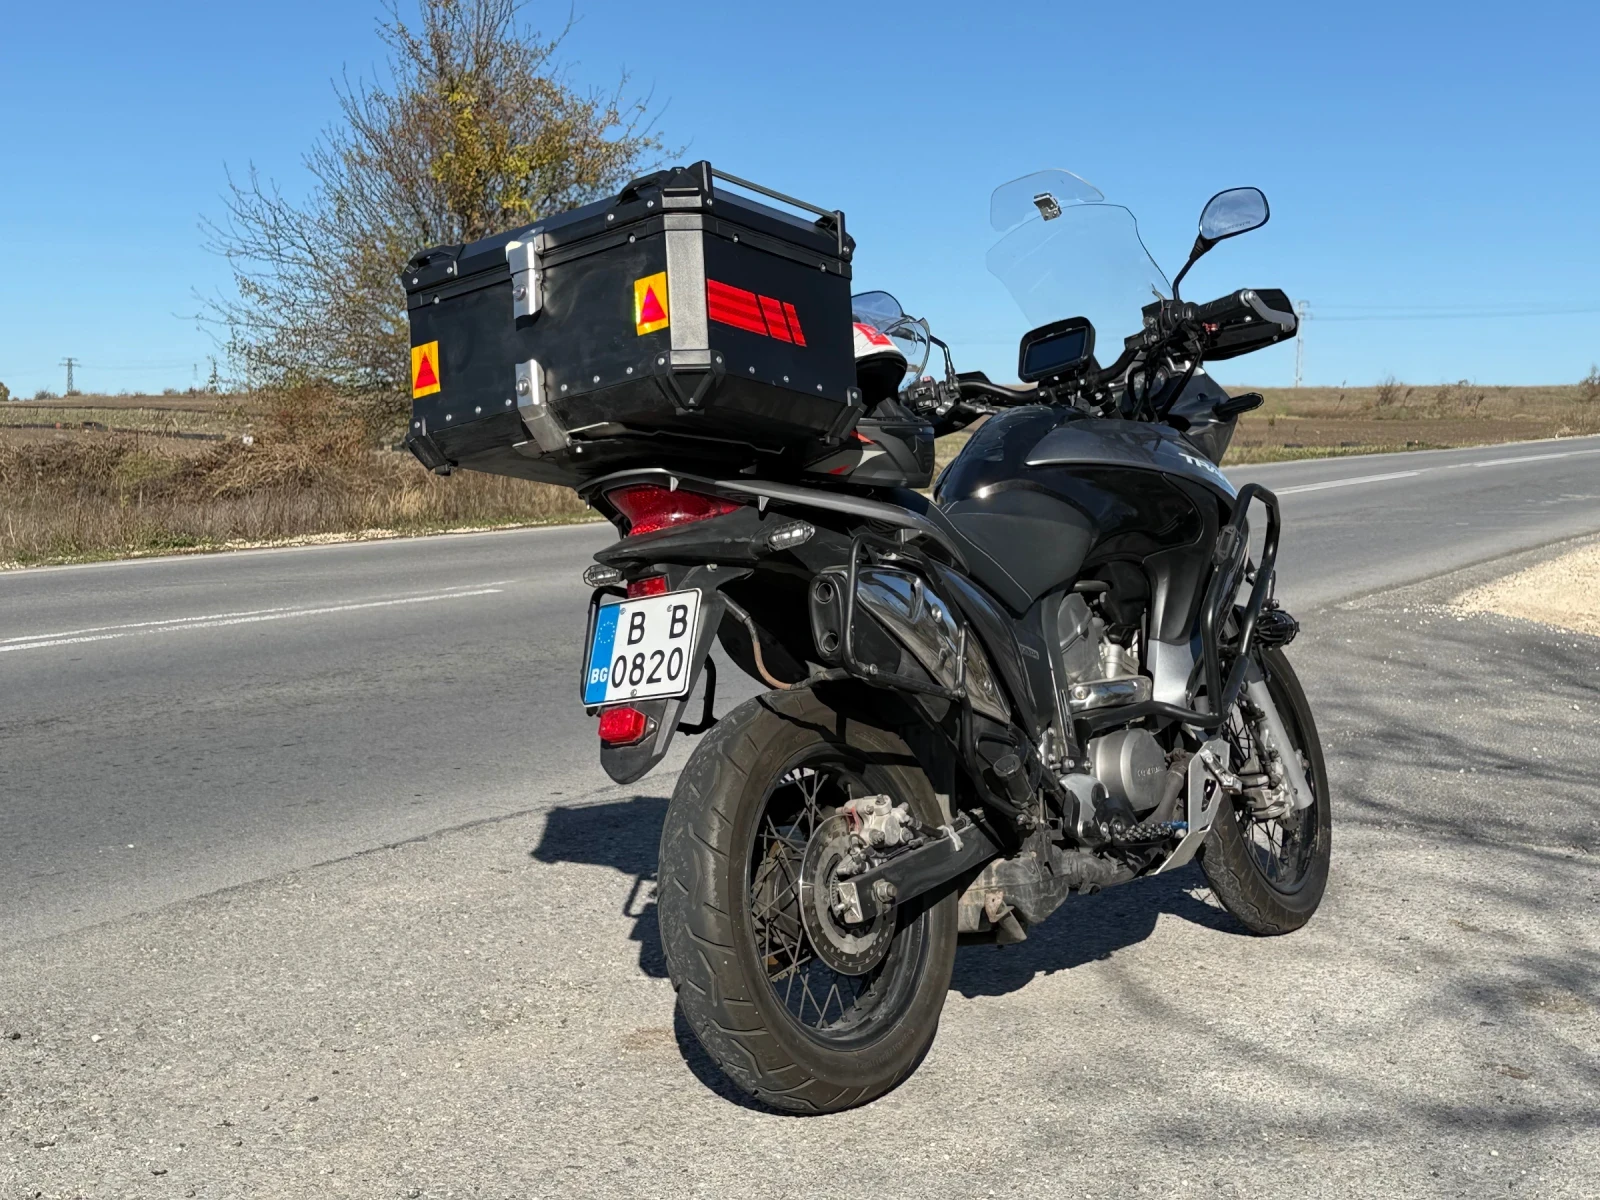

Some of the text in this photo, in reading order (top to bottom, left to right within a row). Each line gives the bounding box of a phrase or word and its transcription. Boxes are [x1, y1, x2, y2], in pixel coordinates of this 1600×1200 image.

[627, 604, 689, 646] B B
[590, 667, 608, 685] BG
[611, 647, 684, 689] 0820
